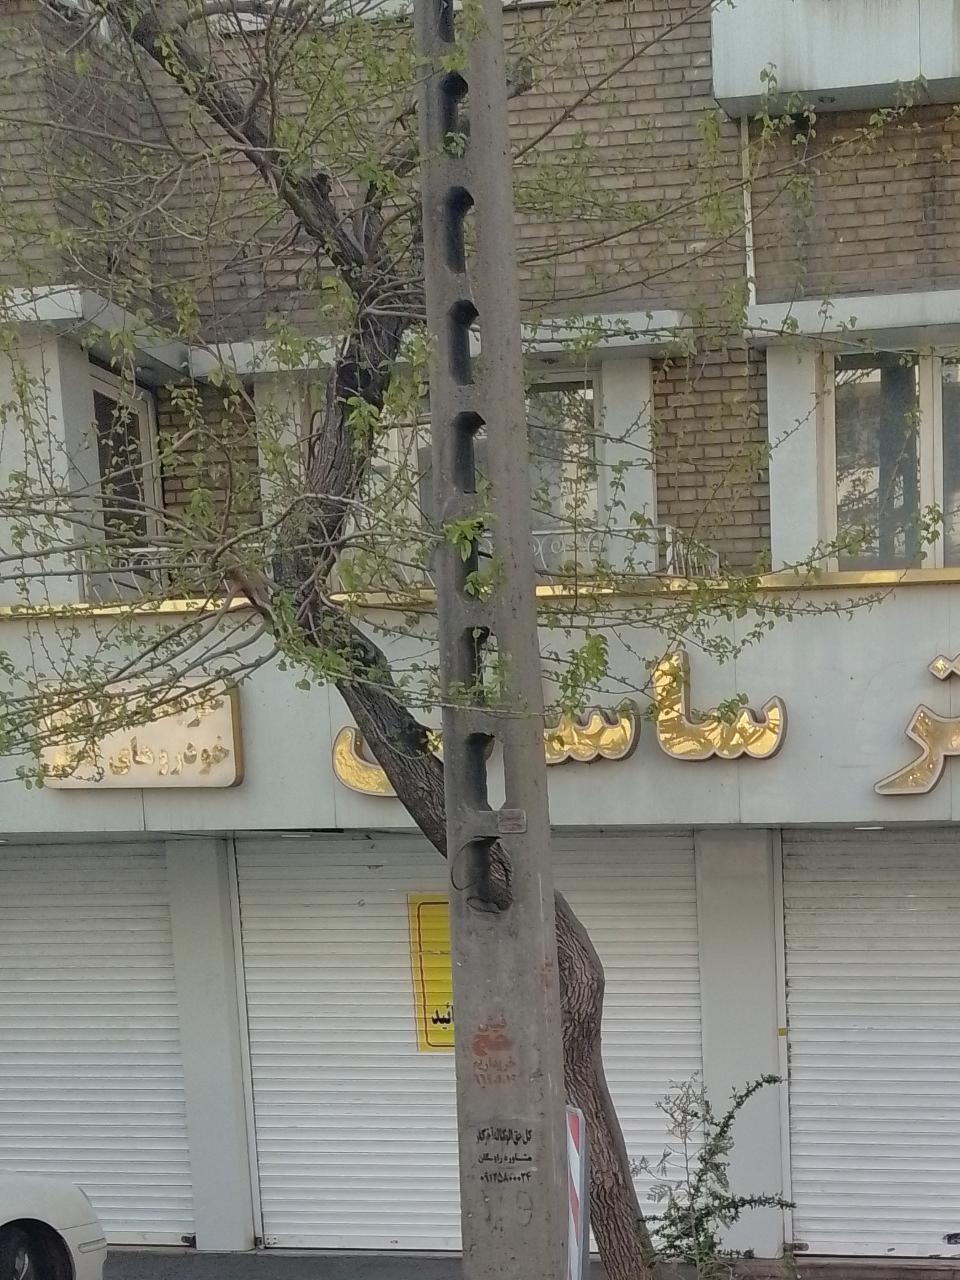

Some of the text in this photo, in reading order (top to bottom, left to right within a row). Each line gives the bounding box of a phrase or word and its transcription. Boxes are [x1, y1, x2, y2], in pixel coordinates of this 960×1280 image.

[331, 648, 788, 798] ساسن
[522, 1127, 533, 1146] کل
[477, 1152, 533, 1164] مشاوره رایگان
